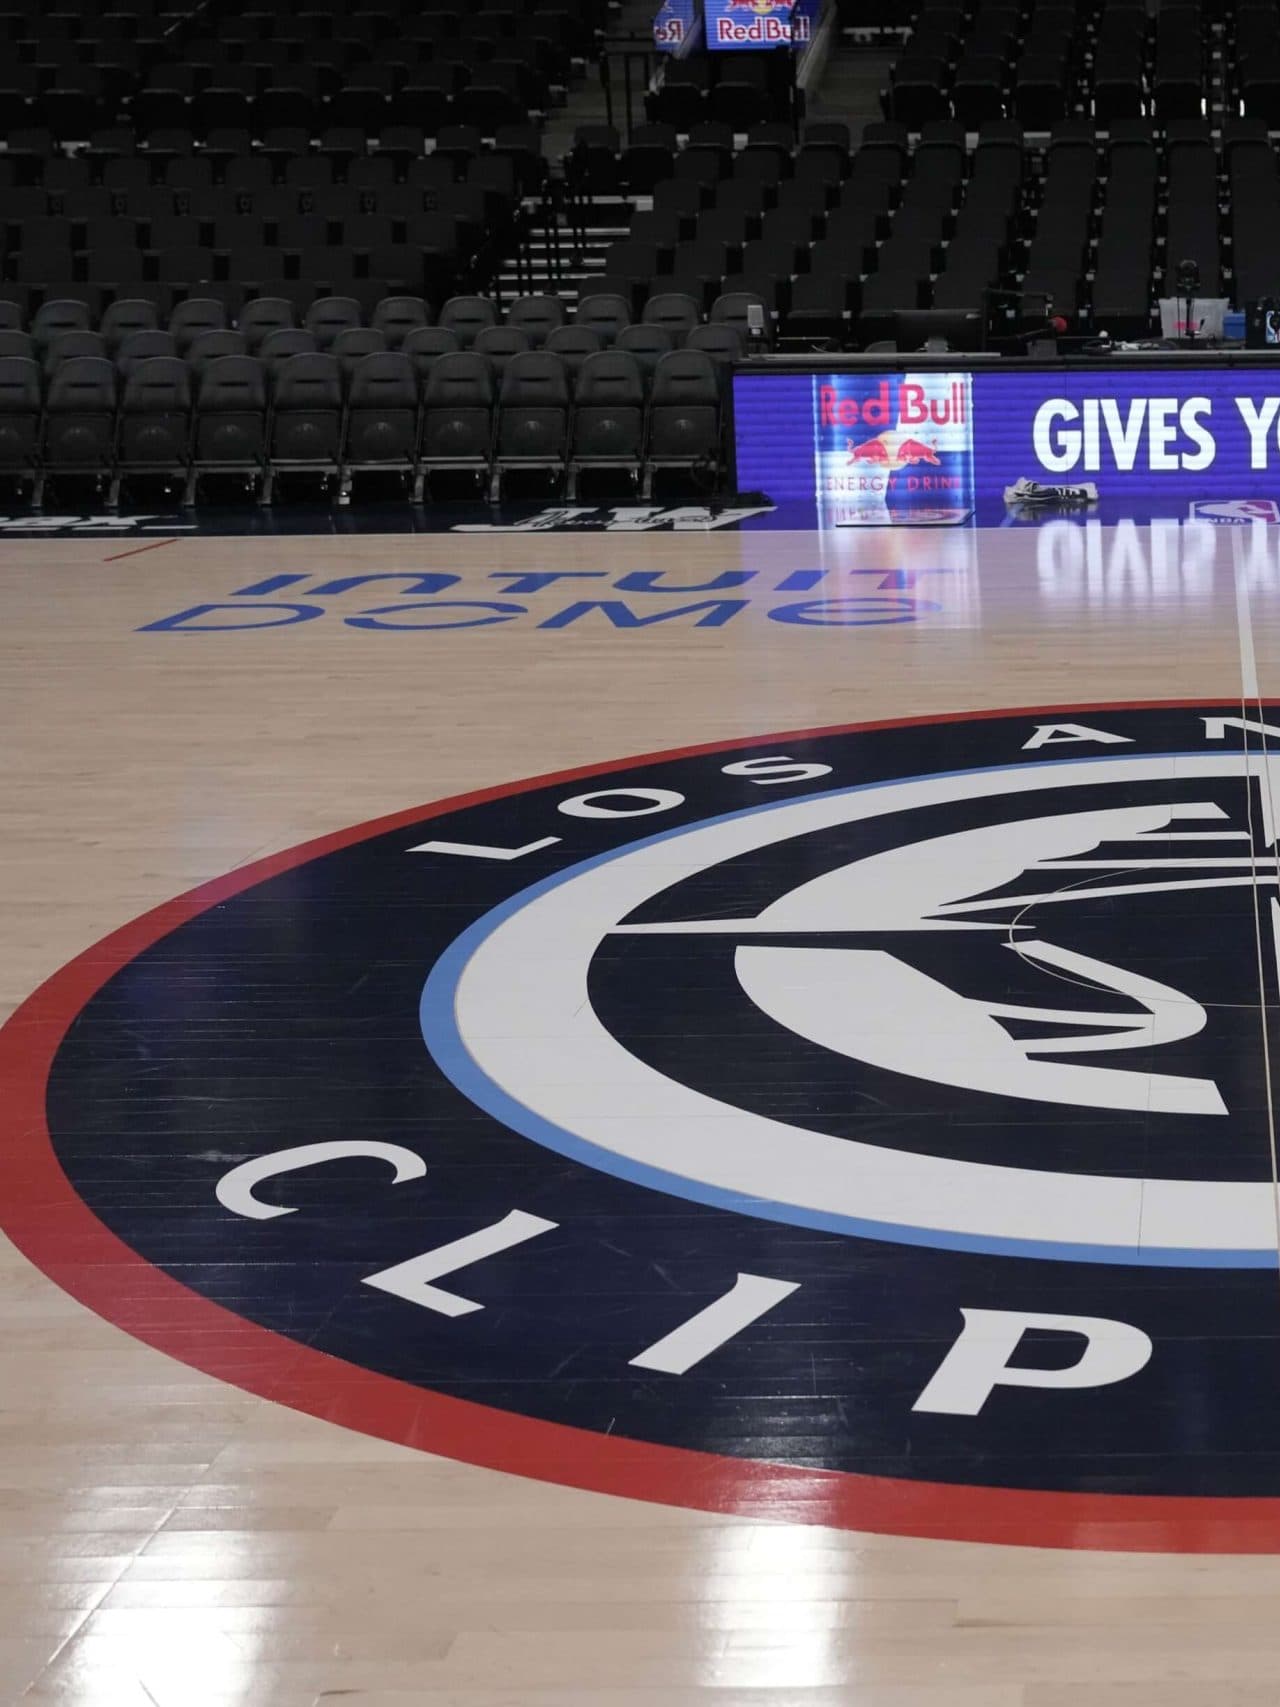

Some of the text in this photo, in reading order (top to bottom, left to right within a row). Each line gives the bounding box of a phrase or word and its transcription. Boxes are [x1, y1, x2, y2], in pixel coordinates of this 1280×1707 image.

[717, 17, 762, 42] Red
[820, 378, 966, 428] Red Bull
[1033, 396, 1217, 472] GIVES
[826, 476, 897, 492] ENERGY
[228, 570, 953, 597] INTUIT
[133, 597, 943, 633] DOME
[404, 755, 834, 861] LOS
